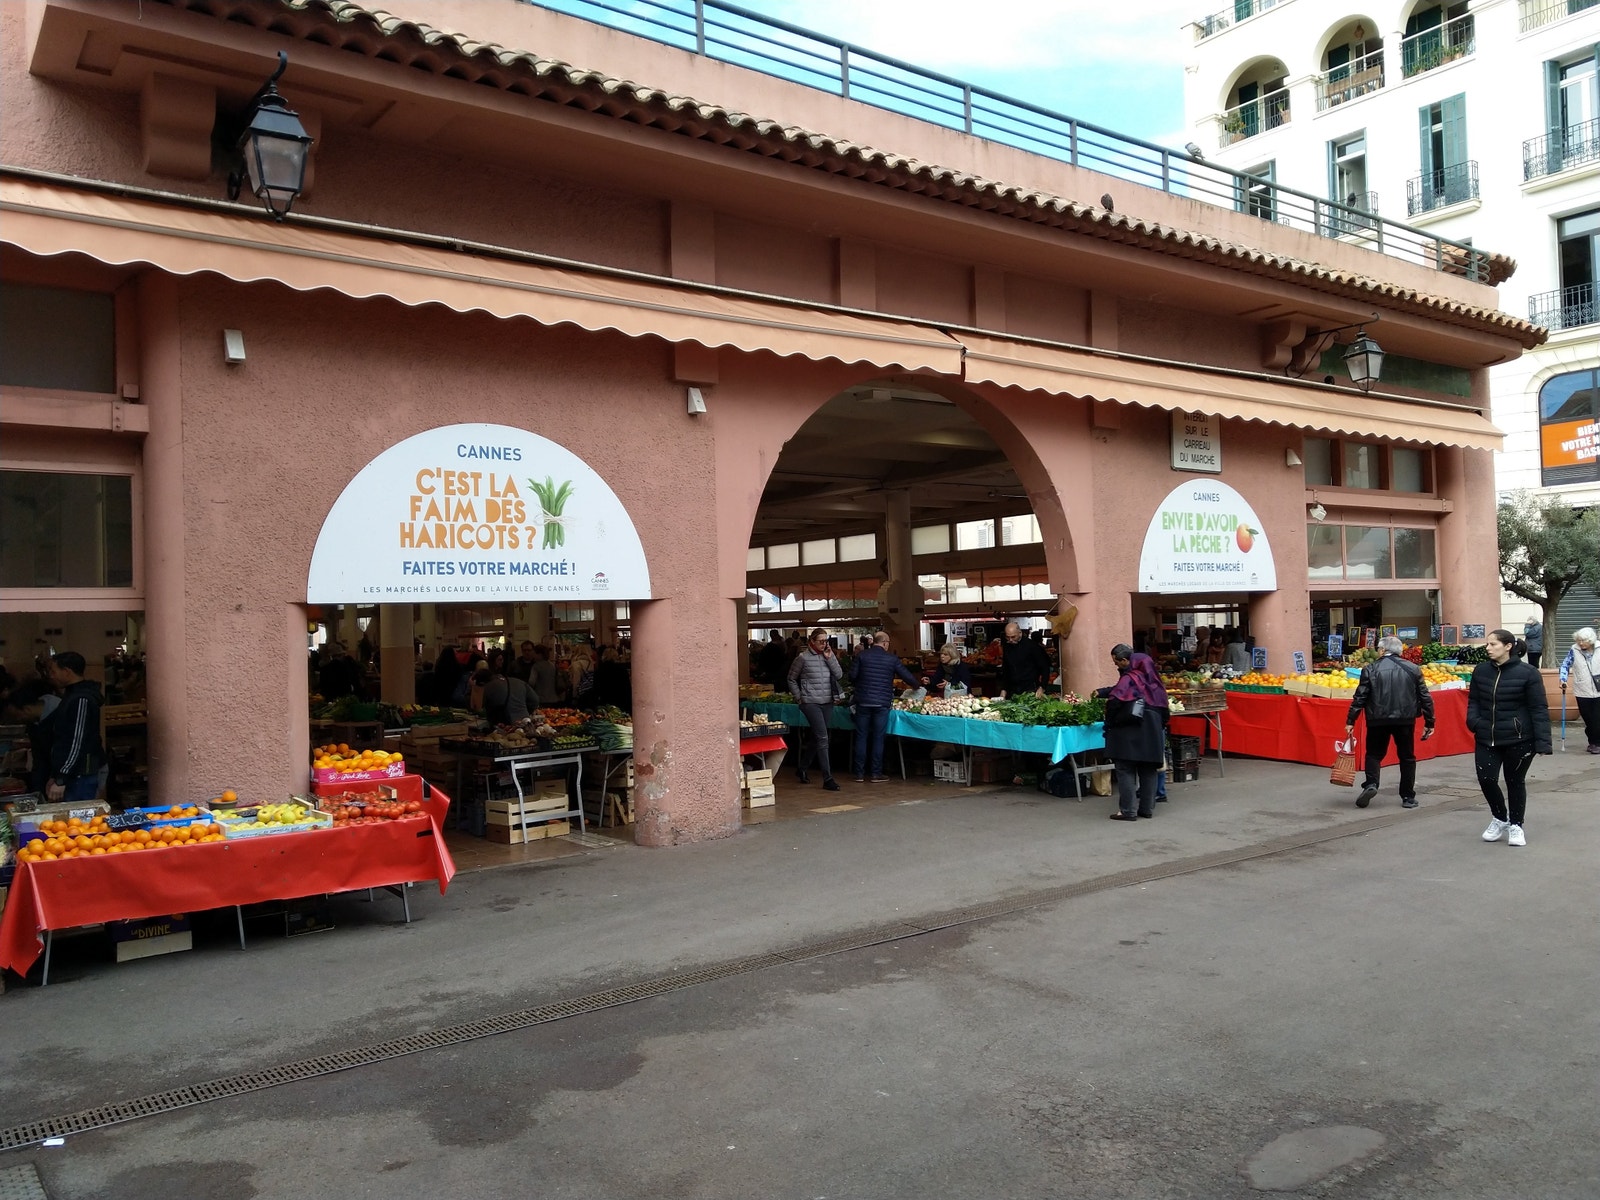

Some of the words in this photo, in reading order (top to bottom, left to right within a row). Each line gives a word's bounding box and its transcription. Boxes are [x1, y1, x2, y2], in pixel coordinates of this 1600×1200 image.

[1185, 425, 1198, 436] SUR
[1200, 426, 1209, 437] LE
[1183, 438, 1211, 450] CARREAU
[1561, 437, 1592, 451] VOTRE
[457, 444, 522, 461] CANNES
[1179, 452, 1189, 462] DU
[415, 467, 483, 497] C'EST
[489, 472, 520, 499] LA
[1193, 492, 1220, 502] CANNES
[410, 495, 478, 523] FAIM
[485, 498, 526, 525] DES
[1162, 511, 1194, 531] ENVIE
[1195, 512, 1238, 532] D'AVOIR
[399, 522, 520, 550] HARICOTS
[525, 525, 537, 550] ?
[1173, 534, 1188, 553] LA
[1190, 532, 1222, 553] PÊCHE
[1224, 535, 1230, 553] ?
[402, 561, 455, 576] FAITES
[459, 561, 506, 576] VOTRE
[510, 558, 568, 576] MARCHÉ
[571, 562, 576, 576] !
[1173, 562, 1195, 572] FAITES
[1195, 562, 1215, 572] VOTRE
[1215, 560, 1241, 572] MARCHÉ
[1241, 562, 1244, 572] !
[386, 585, 431, 593] MARCHÉS
[138, 924, 171, 939] DIVINE
